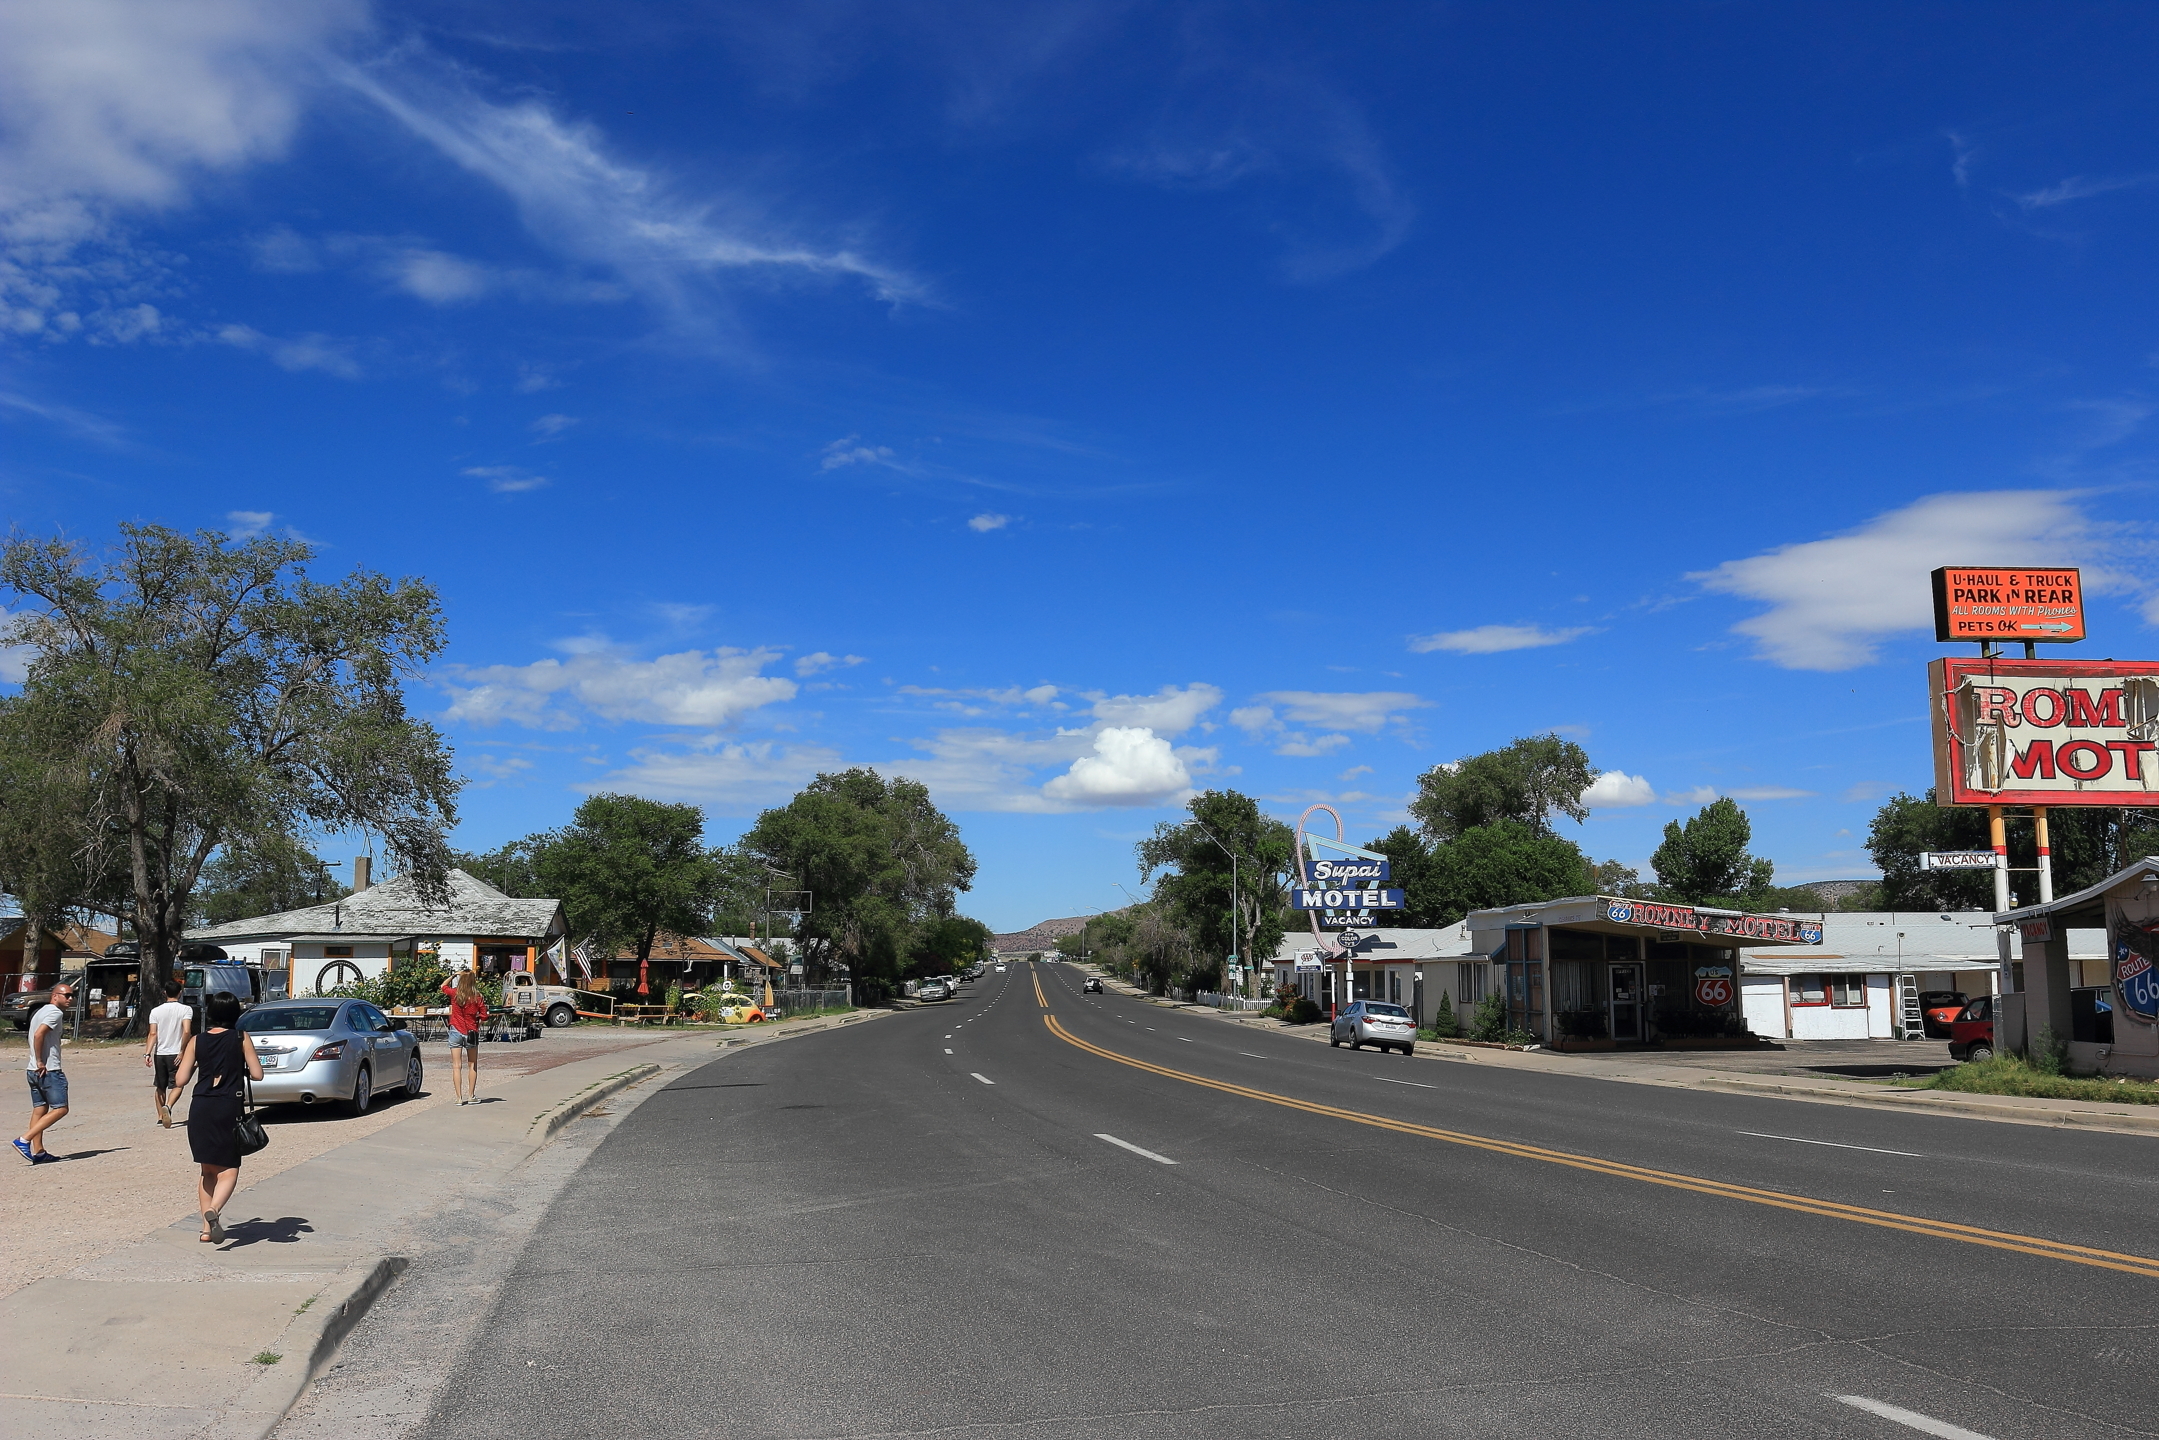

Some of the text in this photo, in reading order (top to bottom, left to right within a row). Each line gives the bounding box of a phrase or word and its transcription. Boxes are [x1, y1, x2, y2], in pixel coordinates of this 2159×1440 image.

[2009, 574, 2020, 586] &
[2025, 575, 2073, 587] TRUCK
[1953, 588, 2002, 603] PARK
[2024, 589, 2074, 603] REAR
[1951, 605, 2077, 617] ALL ROOMS WITH Phones
[1958, 620, 2018, 632] PETS OK
[1937, 854, 1991, 865] VACANCY
[1313, 860, 1382, 886] Supai
[1302, 890, 1397, 907] MOTEL
[1324, 916, 1375, 925] VACANCY
[1611, 908, 1626, 919] 66
[1724, 916, 1800, 941] MOTEL
[1804, 930, 1816, 940] 66
[2021, 922, 2049, 937] VACANCY
[2121, 957, 2150, 978] ROUTE
[1701, 980, 1727, 1001] 66
[2135, 972, 2159, 1005] 66
